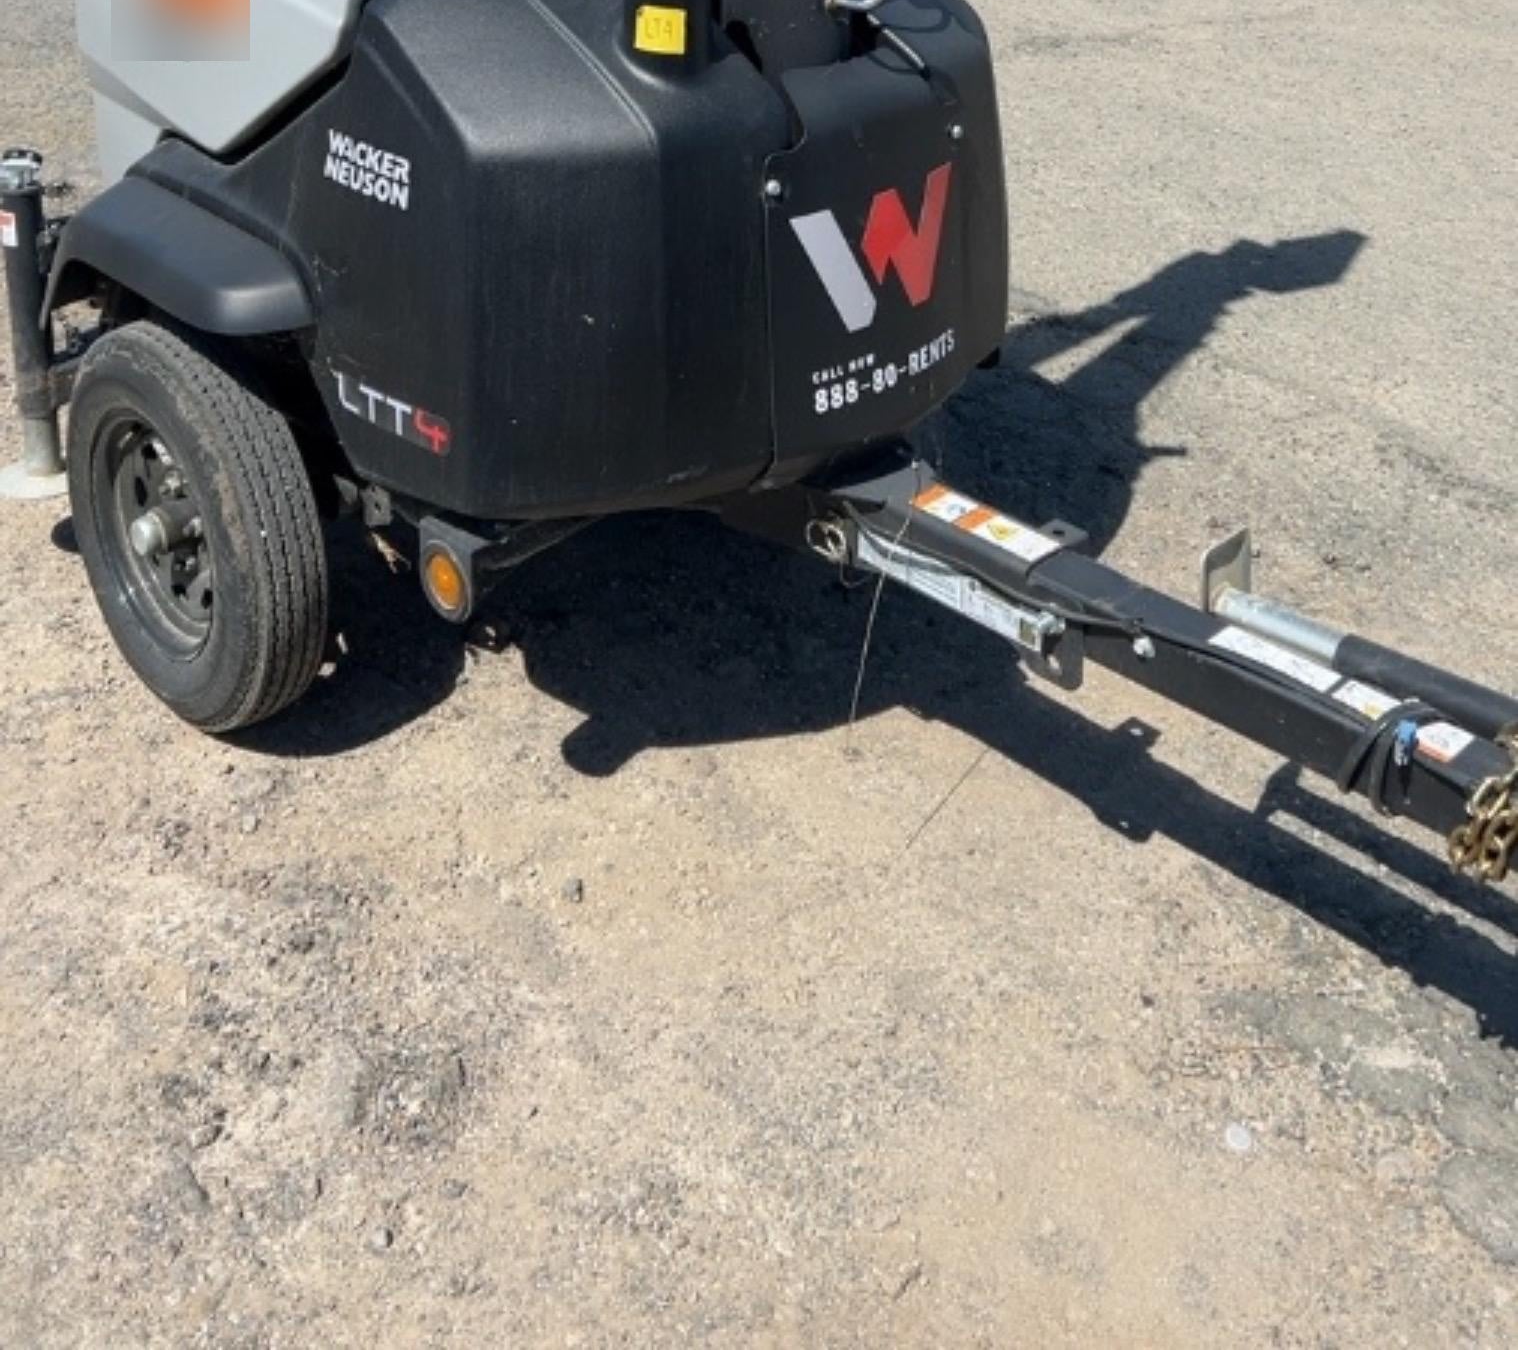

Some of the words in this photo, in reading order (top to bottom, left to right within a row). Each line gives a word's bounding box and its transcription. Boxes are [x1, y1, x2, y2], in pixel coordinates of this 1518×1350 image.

[323, 153, 409, 210] NEUSON
[327, 129, 410, 184] WACKER
[814, 328, 955, 415] 888-80-RENTS
[329, 368, 450, 454] LTT4
